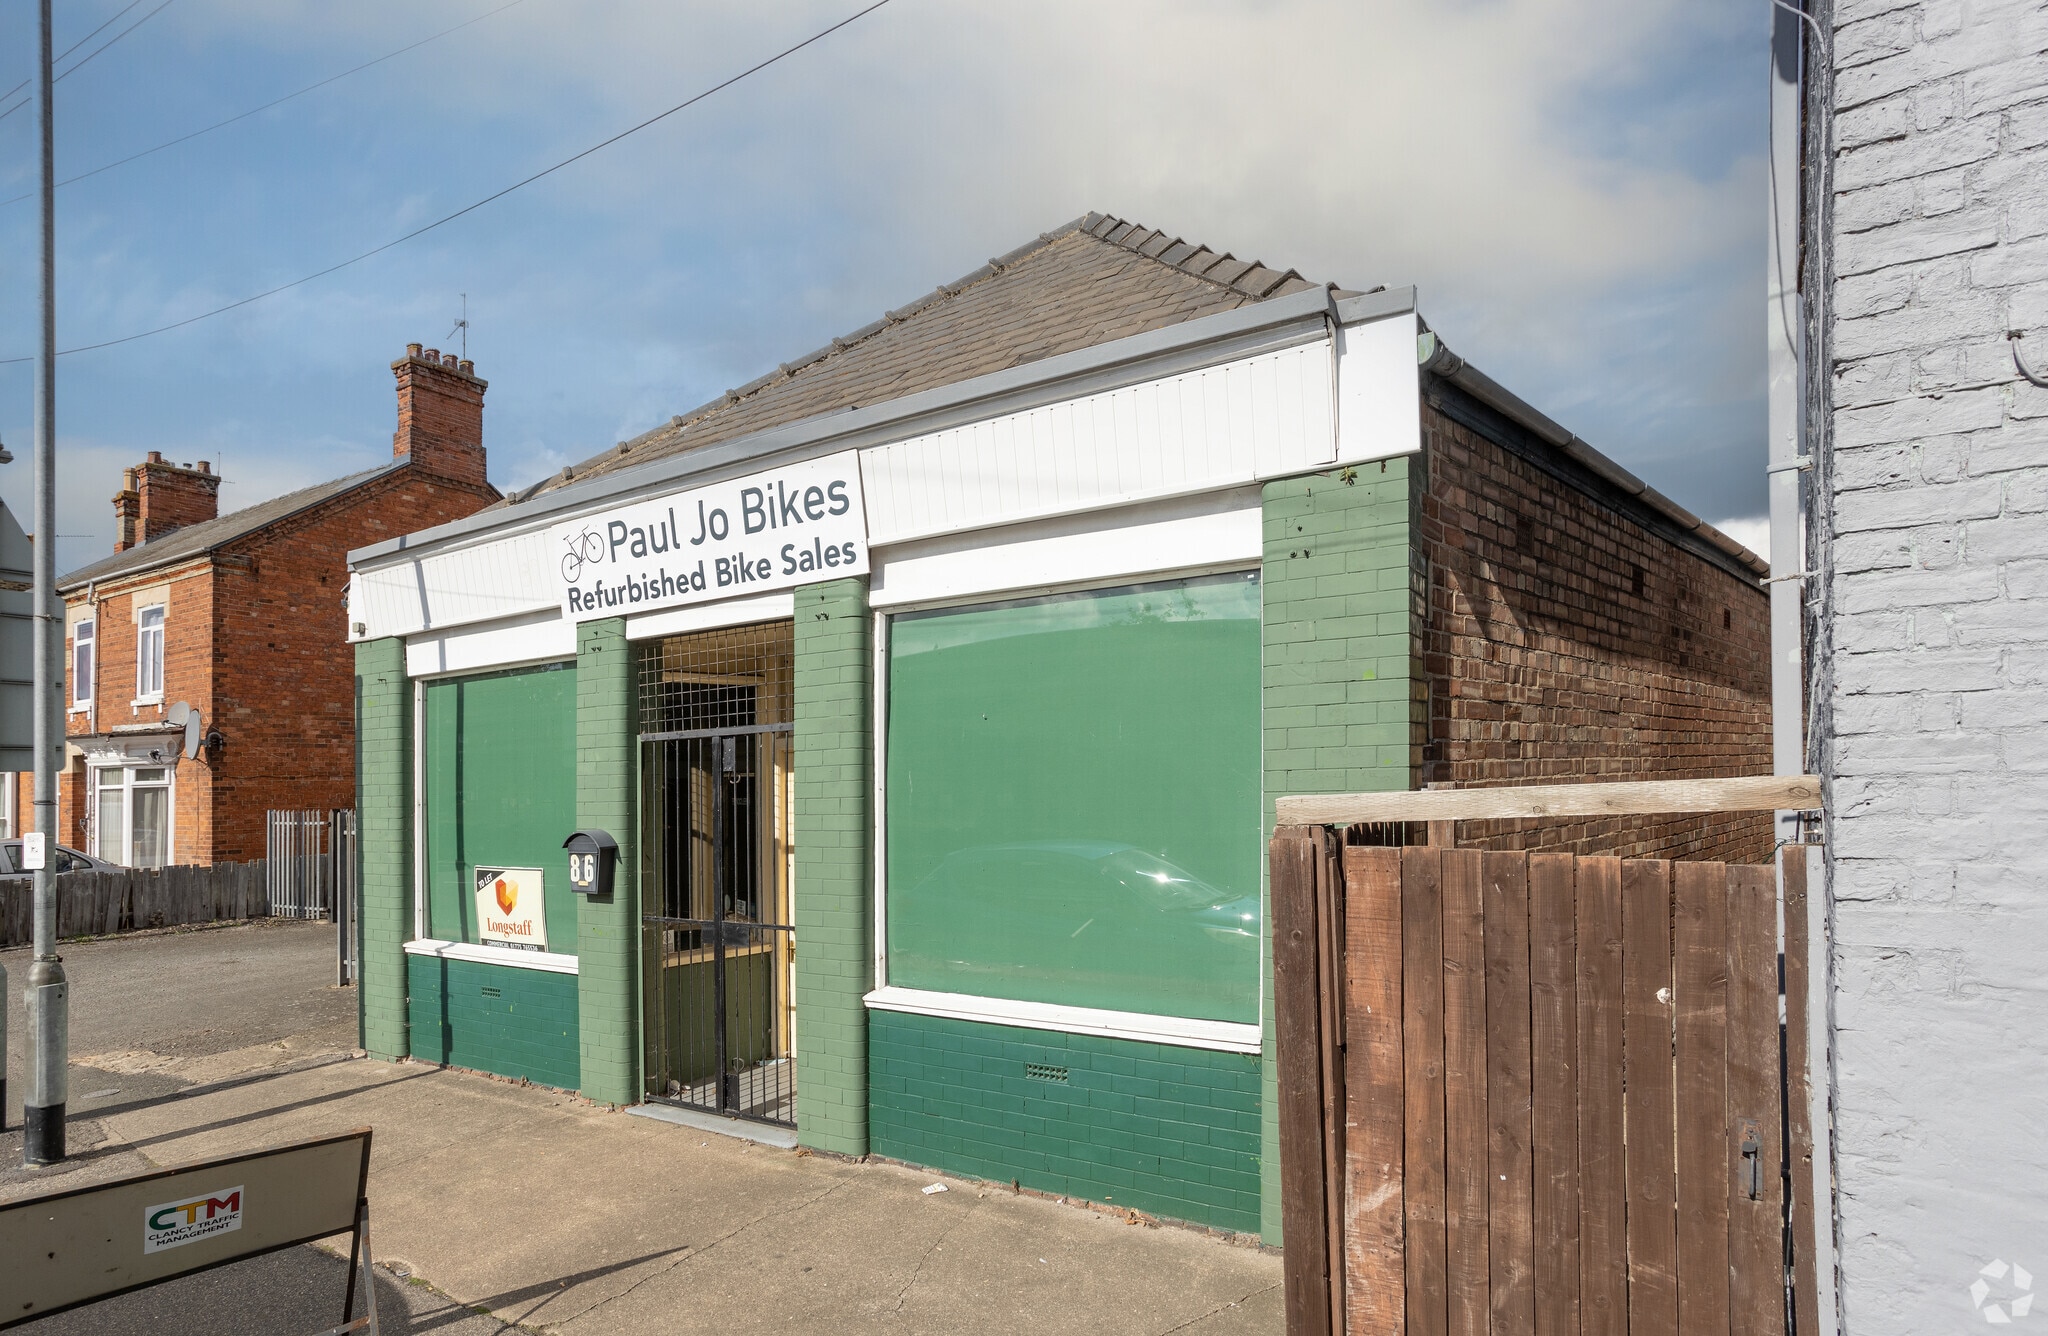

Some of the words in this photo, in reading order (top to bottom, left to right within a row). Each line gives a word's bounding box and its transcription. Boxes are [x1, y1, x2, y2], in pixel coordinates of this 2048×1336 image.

[607, 507, 680, 562] Paul
[690, 500, 729, 546] Jo
[741, 479, 850, 535] Bikes
[568, 560, 706, 613] Refurbished
[715, 552, 772, 587] Bike
[780, 536, 857, 576] Sales
[478, 879, 485, 889] TO
[484, 872, 493, 884] LET
[570, 854, 594, 883] 86
[486, 917, 532, 938] Longstaff
[149, 1191, 240, 1231] CTM
[149, 1225, 194, 1241] CLANCY
[198, 1212, 240, 1228] TRAFFIC
[156, 1221, 231, 1246] MANAGEMENT
